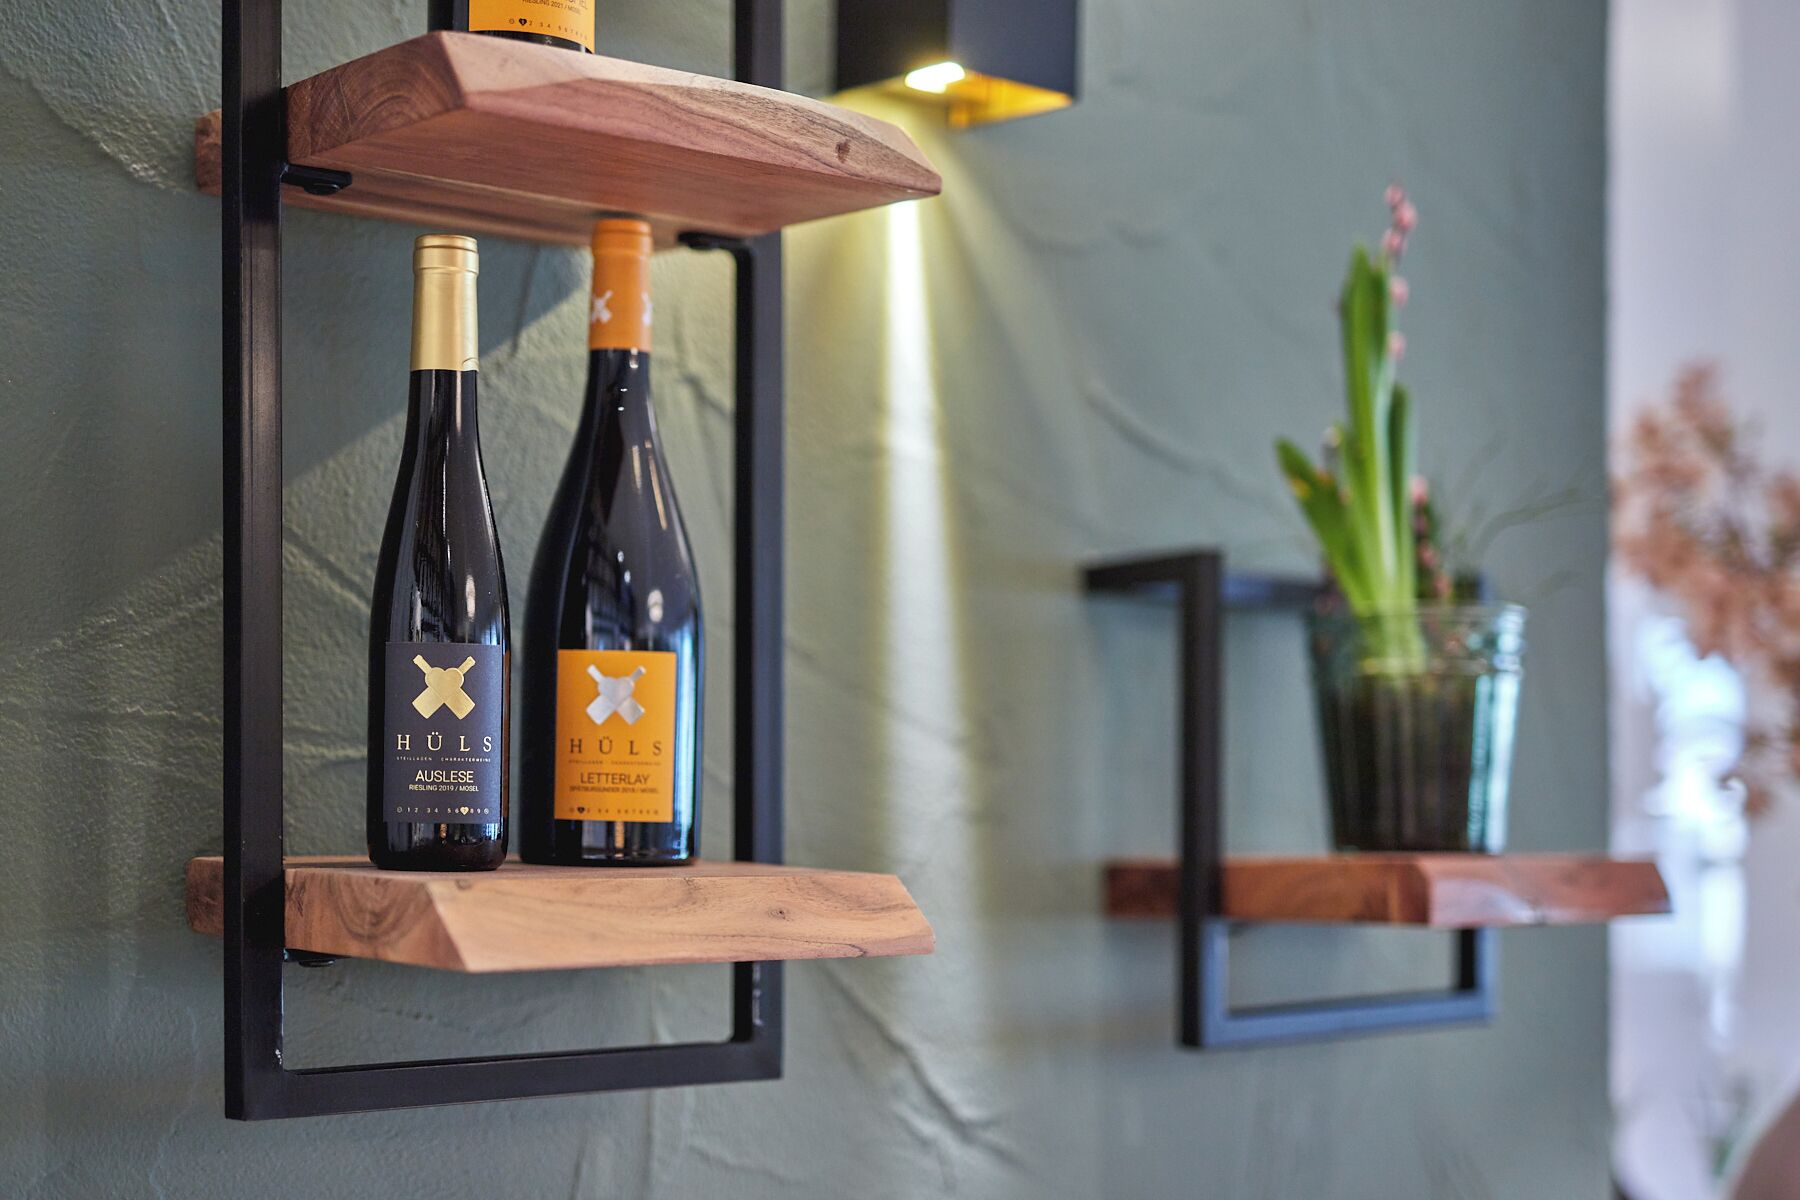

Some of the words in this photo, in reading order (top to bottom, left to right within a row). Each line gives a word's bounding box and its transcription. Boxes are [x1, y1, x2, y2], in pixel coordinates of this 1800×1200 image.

[396, 731, 492, 753] HÜLS
[569, 736, 662, 756] HÜLS
[415, 769, 474, 783] AUSLESE
[580, 772, 650, 785] LETTERLAY
